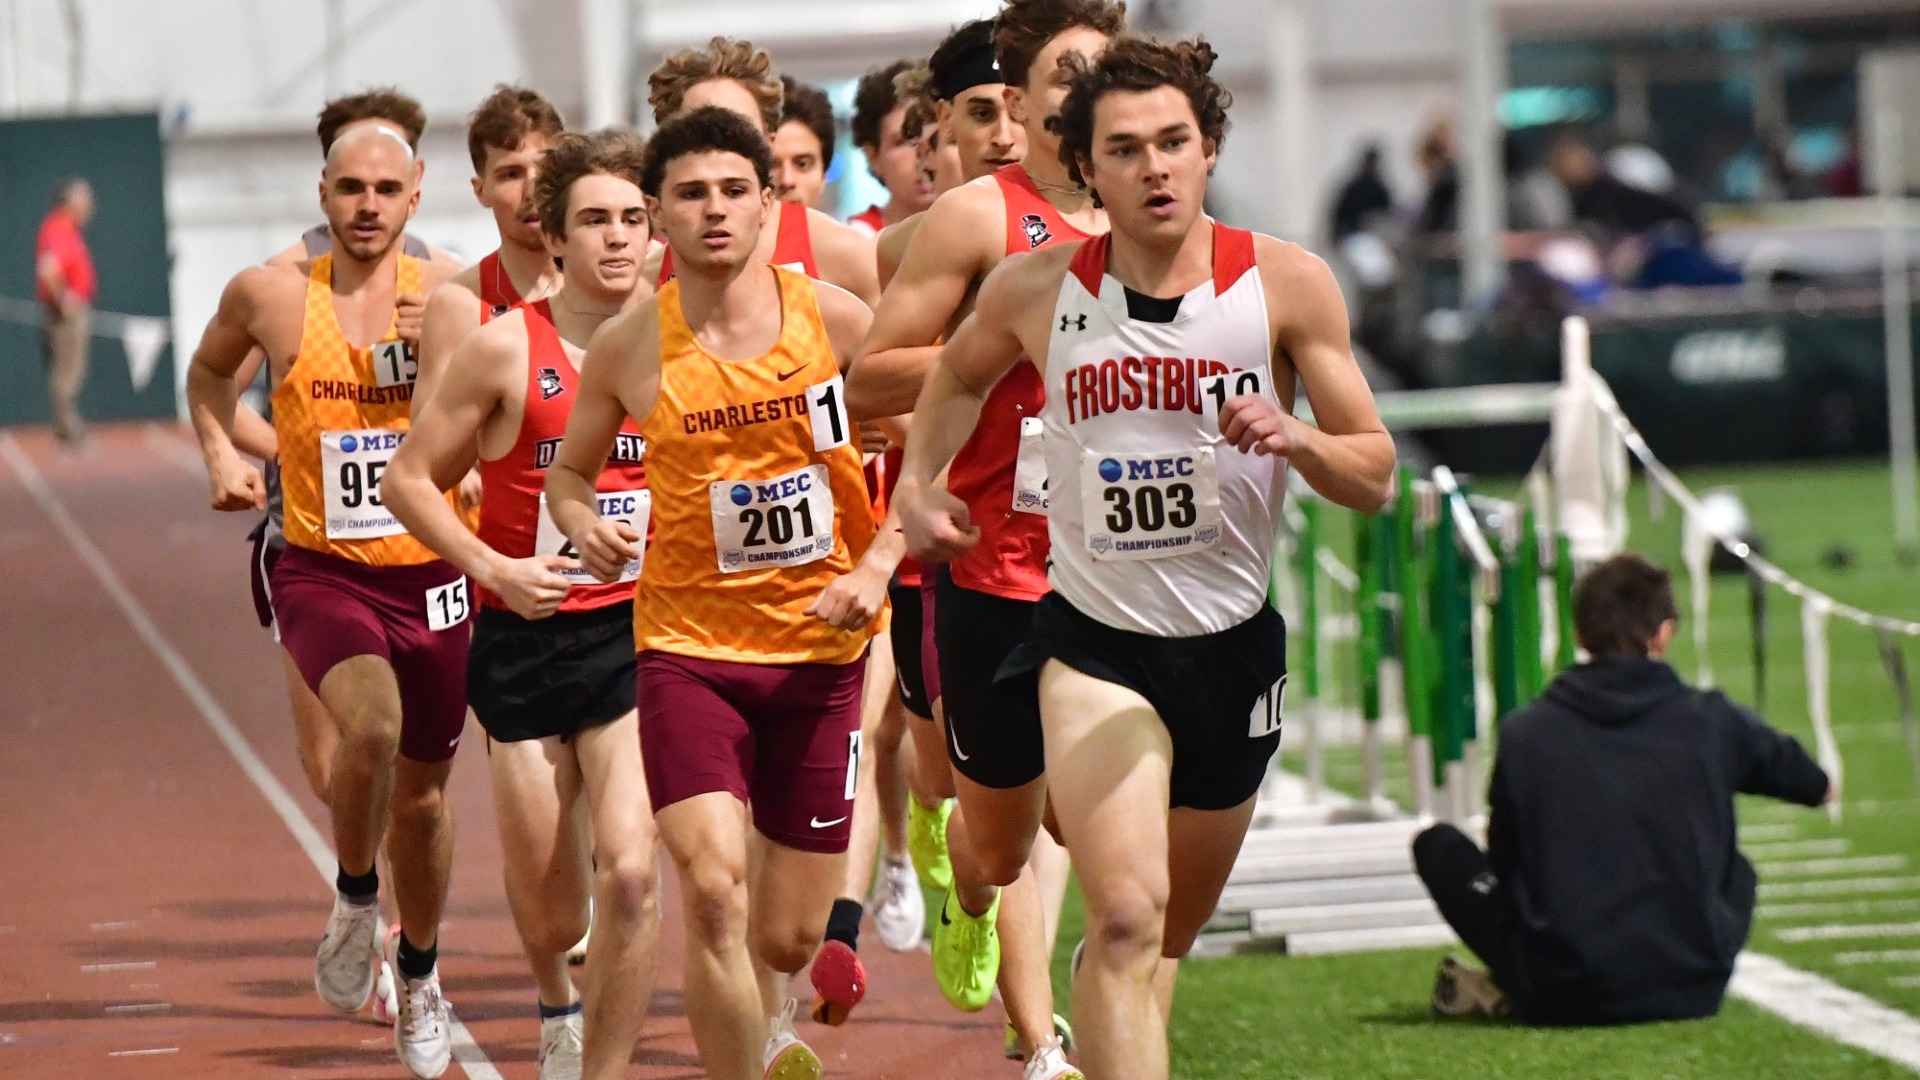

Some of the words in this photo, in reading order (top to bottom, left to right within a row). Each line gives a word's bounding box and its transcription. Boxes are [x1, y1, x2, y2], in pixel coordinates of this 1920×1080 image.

[1065, 355, 1245, 425] FROSTBU
[683, 394, 808, 434] CHARLESTO
[817, 385, 844, 443] 1
[615, 436, 648, 462] ELK
[1126, 456, 1194, 481] MEC
[340, 461, 388, 508] 95
[756, 473, 812, 503] MEC
[347, 517, 400, 529] CHAMPIONS
[738, 497, 814, 548] 201
[1103, 482, 1197, 534] 303
[747, 544, 814, 563] CHAMPIONSHIP
[1115, 535, 1193, 552] CHAMPIONSHIP
[436, 582, 465, 625] 15
